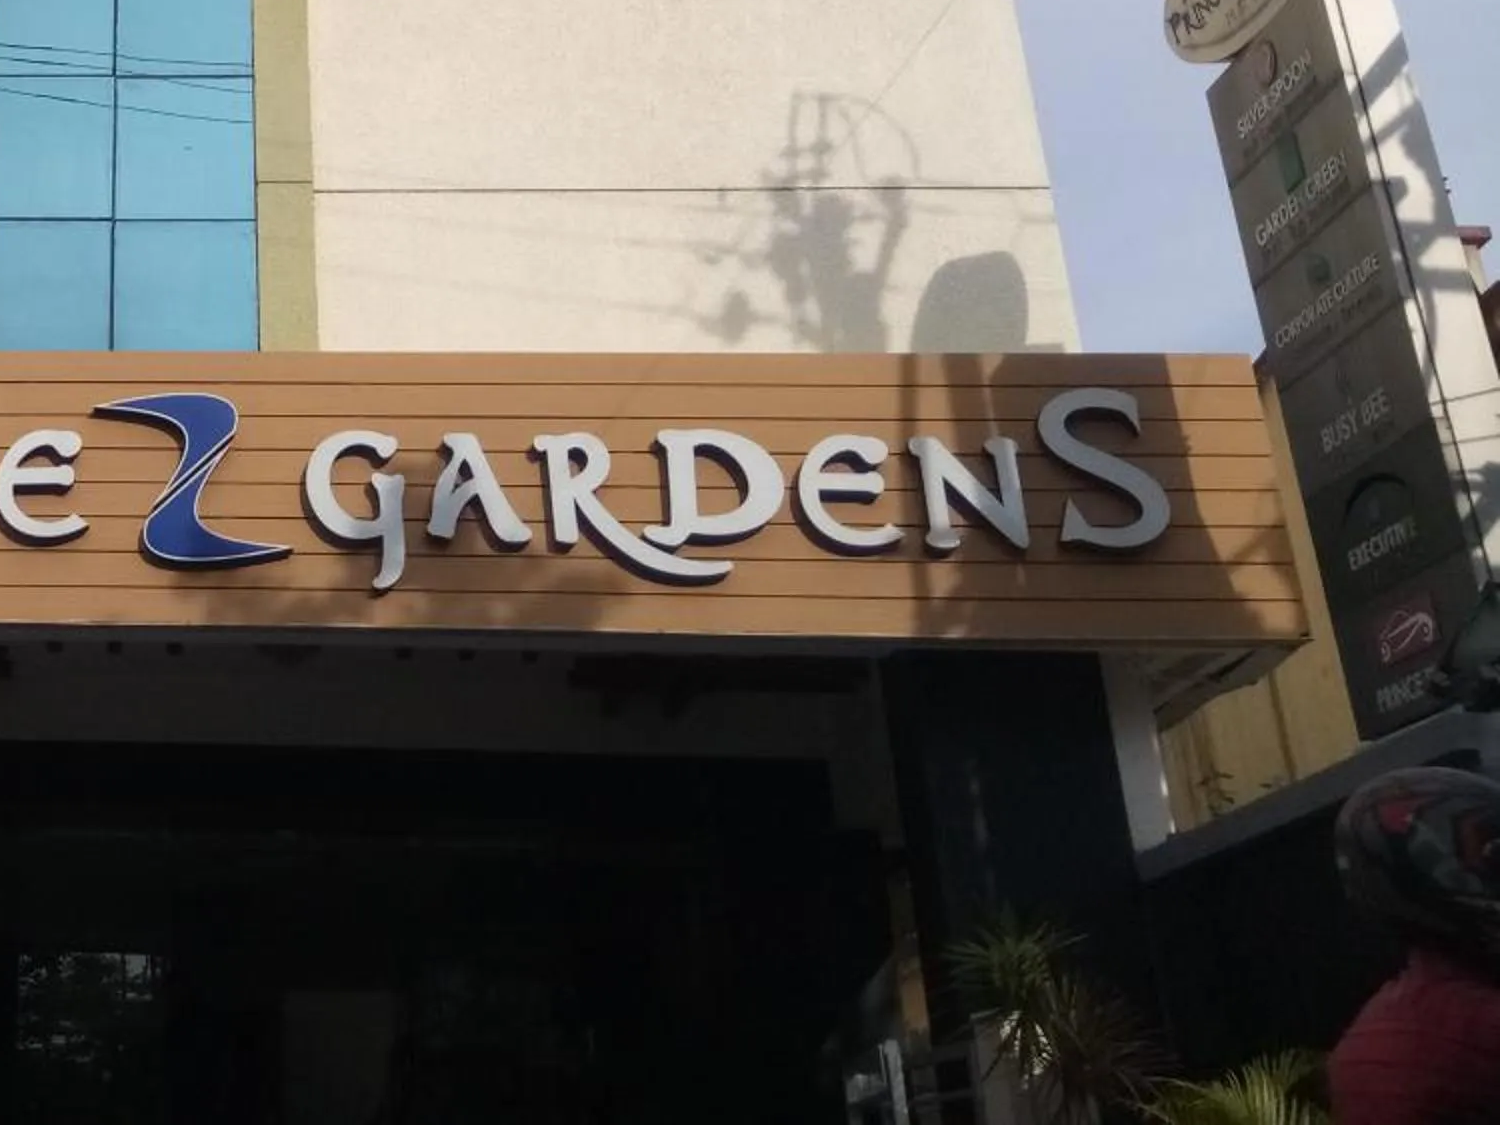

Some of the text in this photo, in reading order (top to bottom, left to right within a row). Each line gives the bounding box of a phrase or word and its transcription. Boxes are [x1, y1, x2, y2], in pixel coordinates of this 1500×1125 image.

[1269, 49, 1312, 102] SPOON
[1304, 151, 1347, 199] GREEN
[1320, 386, 1391, 454] BUSY BEE
[303, 386, 1172, 593] GARDENS
